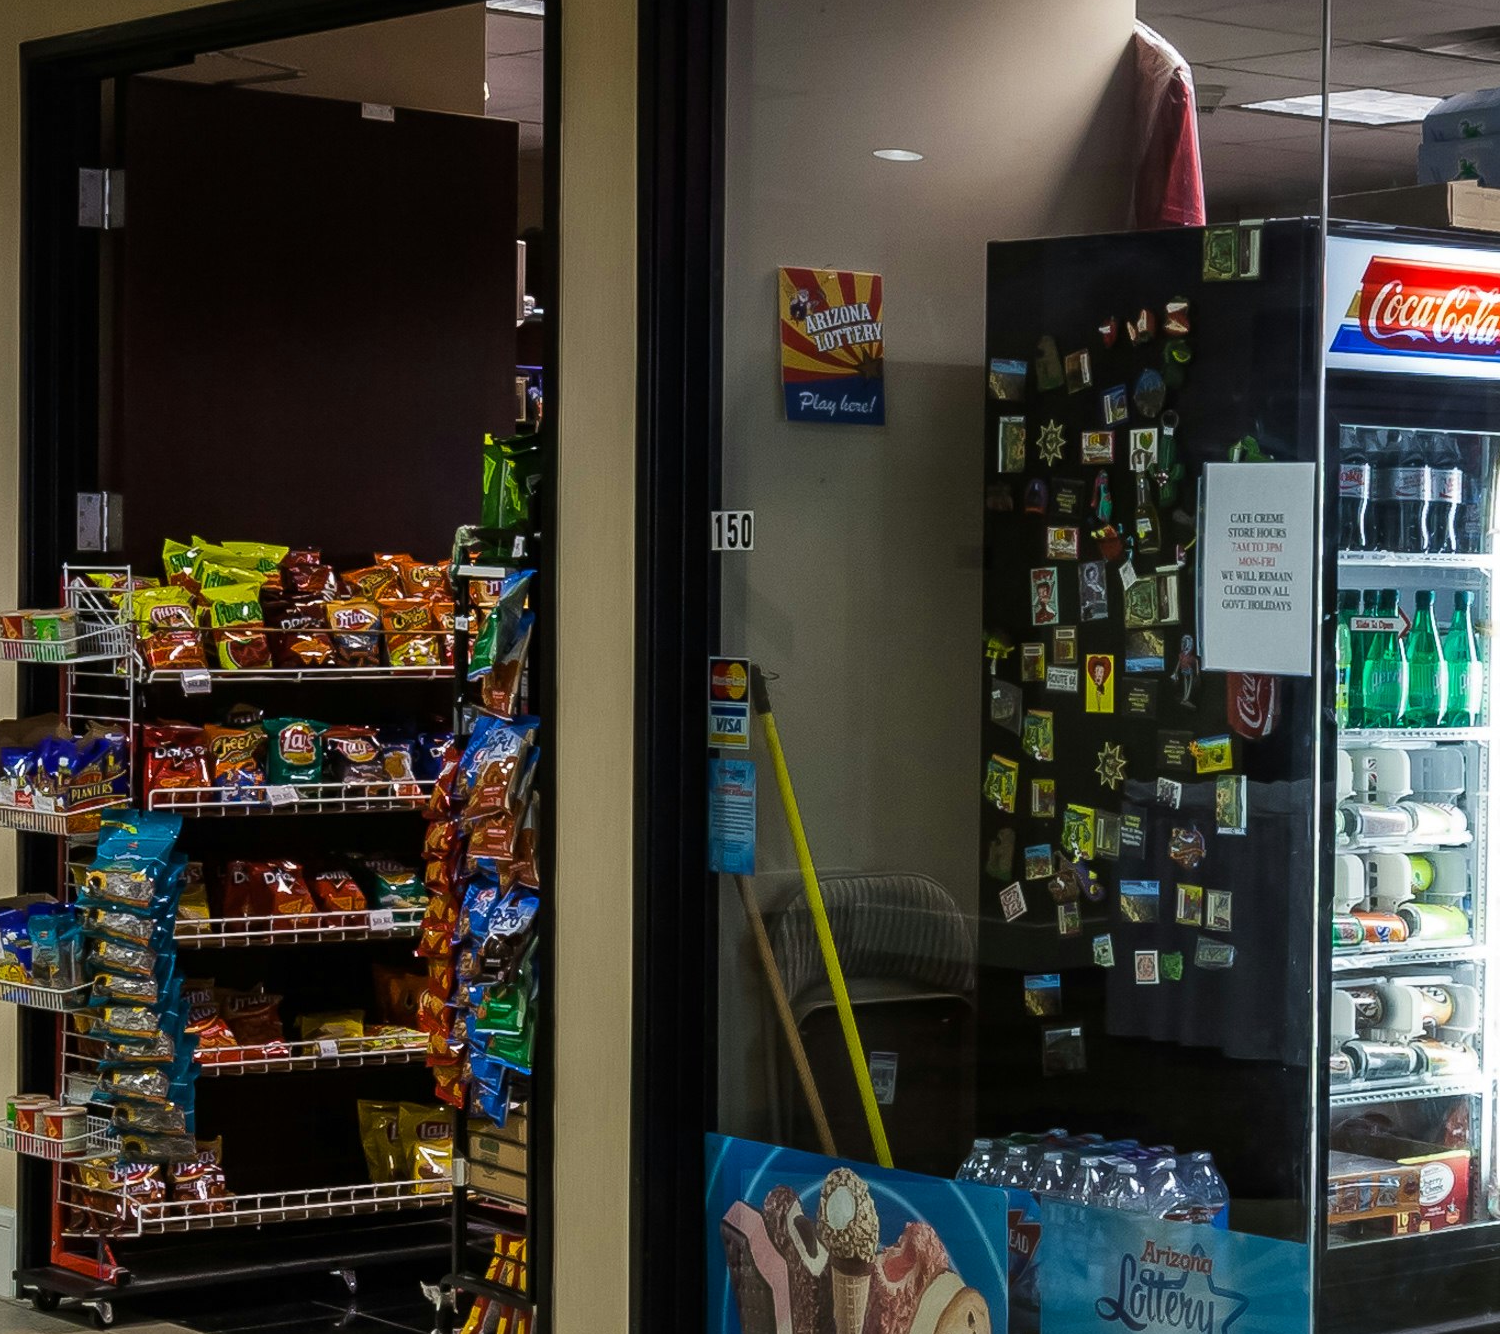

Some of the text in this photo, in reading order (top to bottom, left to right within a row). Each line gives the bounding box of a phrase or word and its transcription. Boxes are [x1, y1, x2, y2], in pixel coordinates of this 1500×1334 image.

[805, 303, 872, 334] ARIZONA
[815, 322, 884, 352] LOTTERY
[799, 391, 877, 417] Play here!
[1230, 514, 1284, 523] CAFE CREME
[714, 514, 752, 549] 150
[1228, 528, 1287, 538] STORE HOURS
[1221, 571, 1293, 582] WE WILL REMAIN
[1224, 585, 1290, 596] CLOSED ON ALL
[1248, 600, 1292, 611] HOLIDAYS
[716, 718, 742, 733] VISA
[71, 783, 114, 802] PLANTERS
[1139, 1240, 1214, 1275] Arizona
[1095, 1254, 1220, 1333] Lottery
